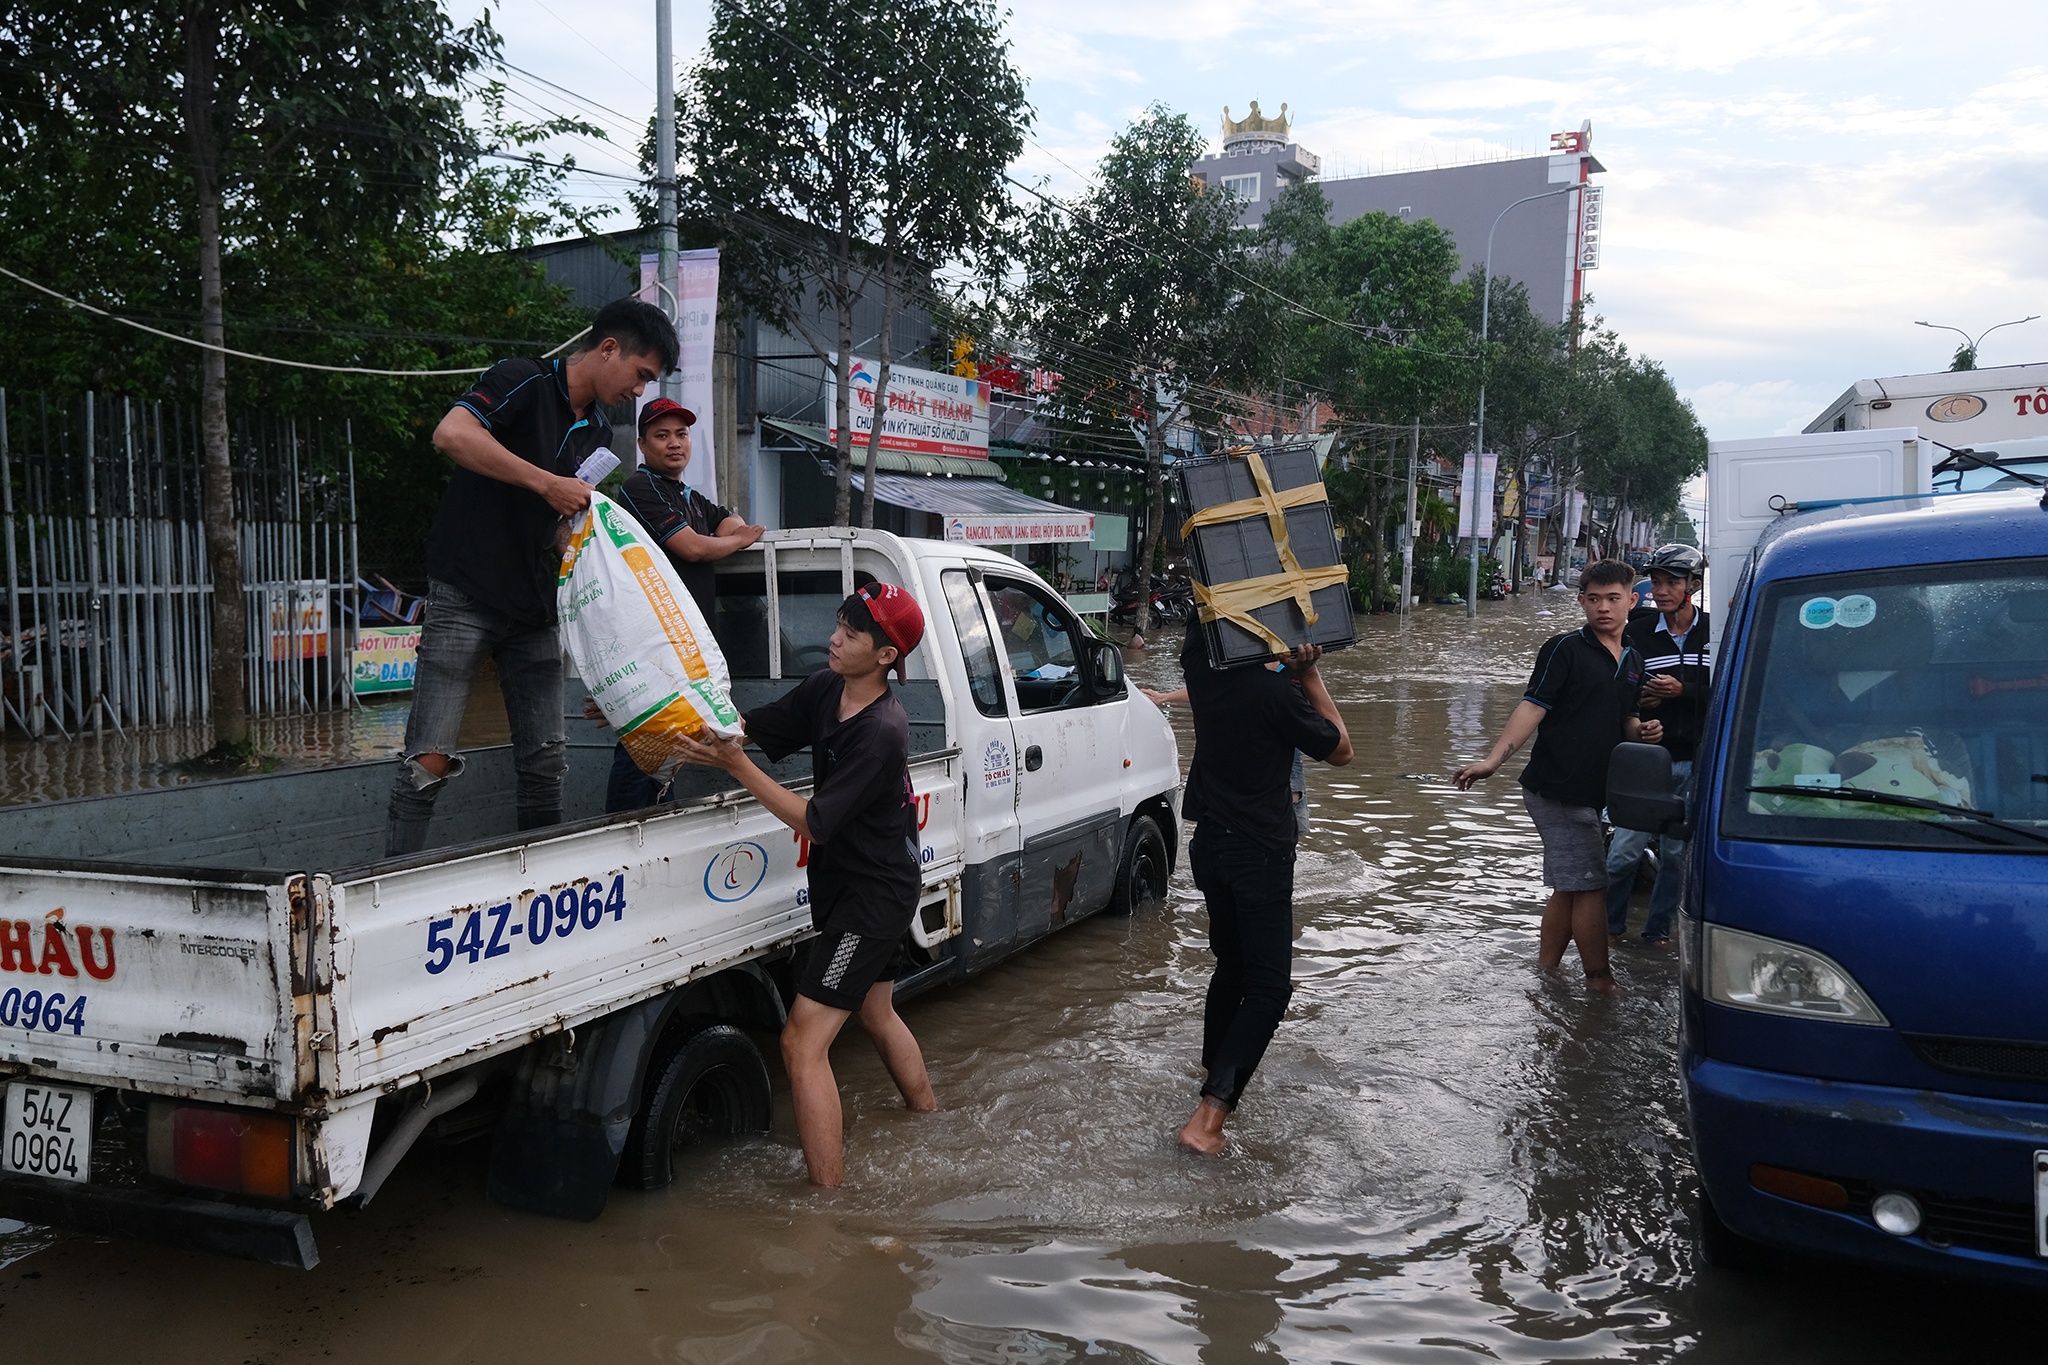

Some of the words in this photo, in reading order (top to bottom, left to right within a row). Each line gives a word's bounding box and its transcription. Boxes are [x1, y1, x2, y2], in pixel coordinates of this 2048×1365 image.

[897, 374, 906, 384] TY
[907, 376, 925, 387] TNHH
[888, 420, 896, 433] IN
[383, 635, 399, 653] VỊT
[684, 633, 694, 645] 20
[621, 661, 639, 679] VỊT
[425, 873, 627, 975] 54Z-0964
[181, 943, 256, 960] INTERCOOLER
[23, 1088, 73, 1133] 54Z
[12, 1131, 78, 1178] 0964
